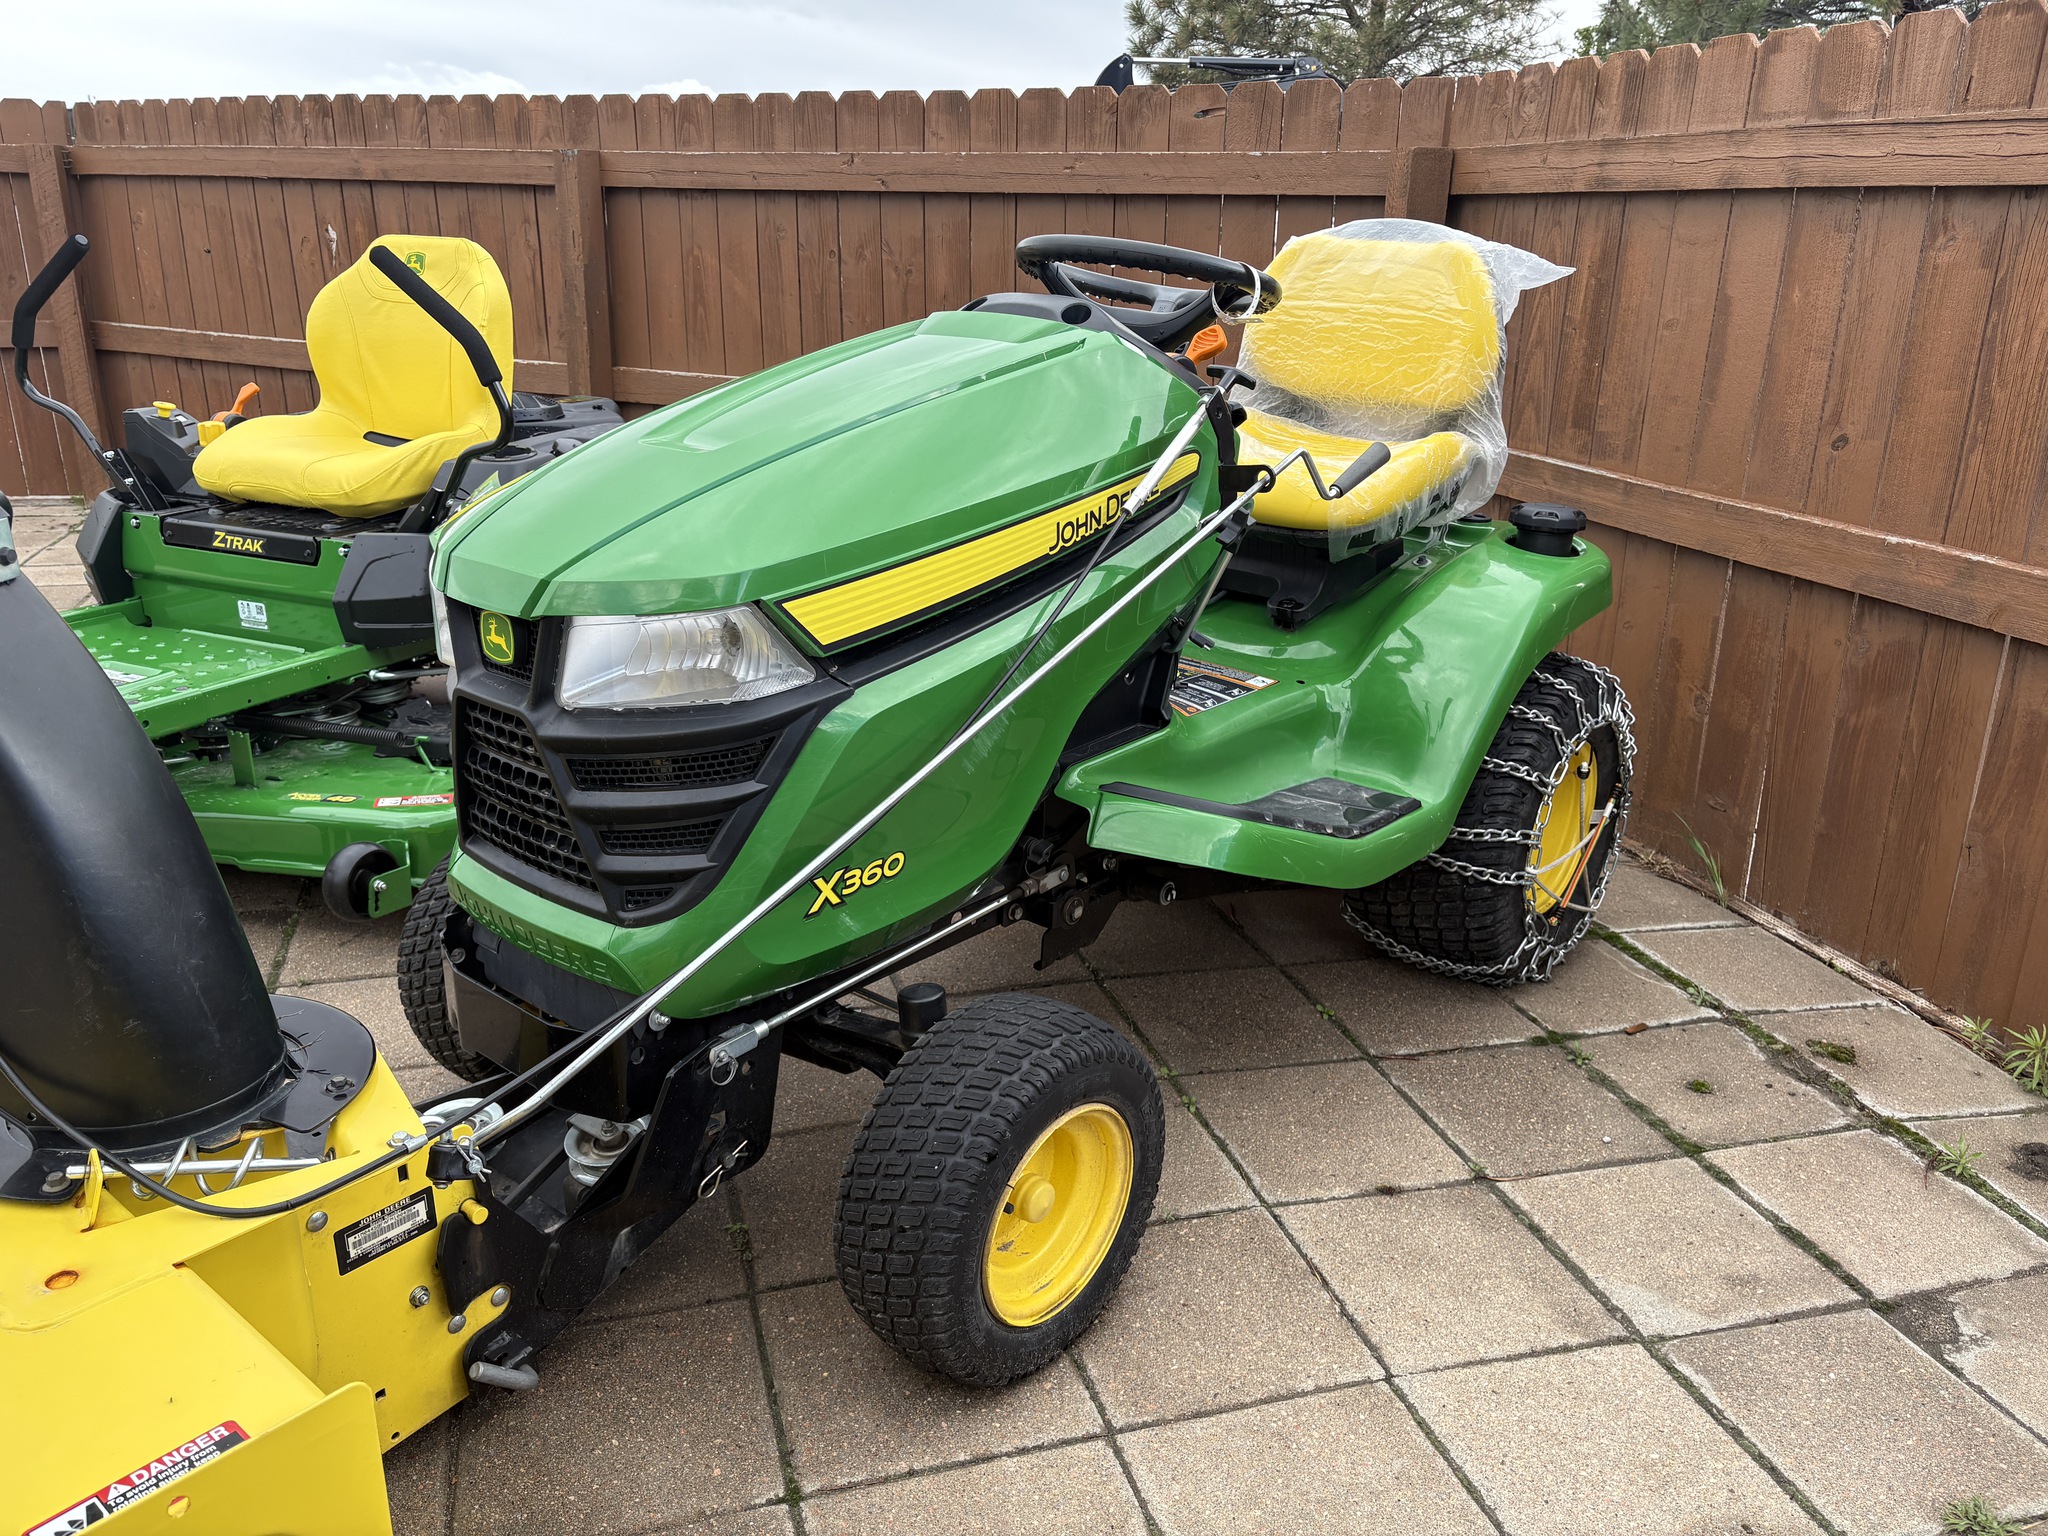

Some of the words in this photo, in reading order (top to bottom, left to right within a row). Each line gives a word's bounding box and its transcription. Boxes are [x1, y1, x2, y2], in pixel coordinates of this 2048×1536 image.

[213, 530, 264, 553] ZTRAK
[1049, 506, 1103, 554] JOHN
[804, 851, 906, 918] X360
[509, 916, 613, 983] DEERE
[359, 1212, 382, 1226] JOHN
[384, 1196, 411, 1213] DEERE
[107, 1496, 124, 1507] To
[125, 1477, 158, 1496] avoid
[158, 1460, 189, 1481] injury
[190, 1444, 217, 1462] from
[130, 1426, 230, 1485] DANGER
